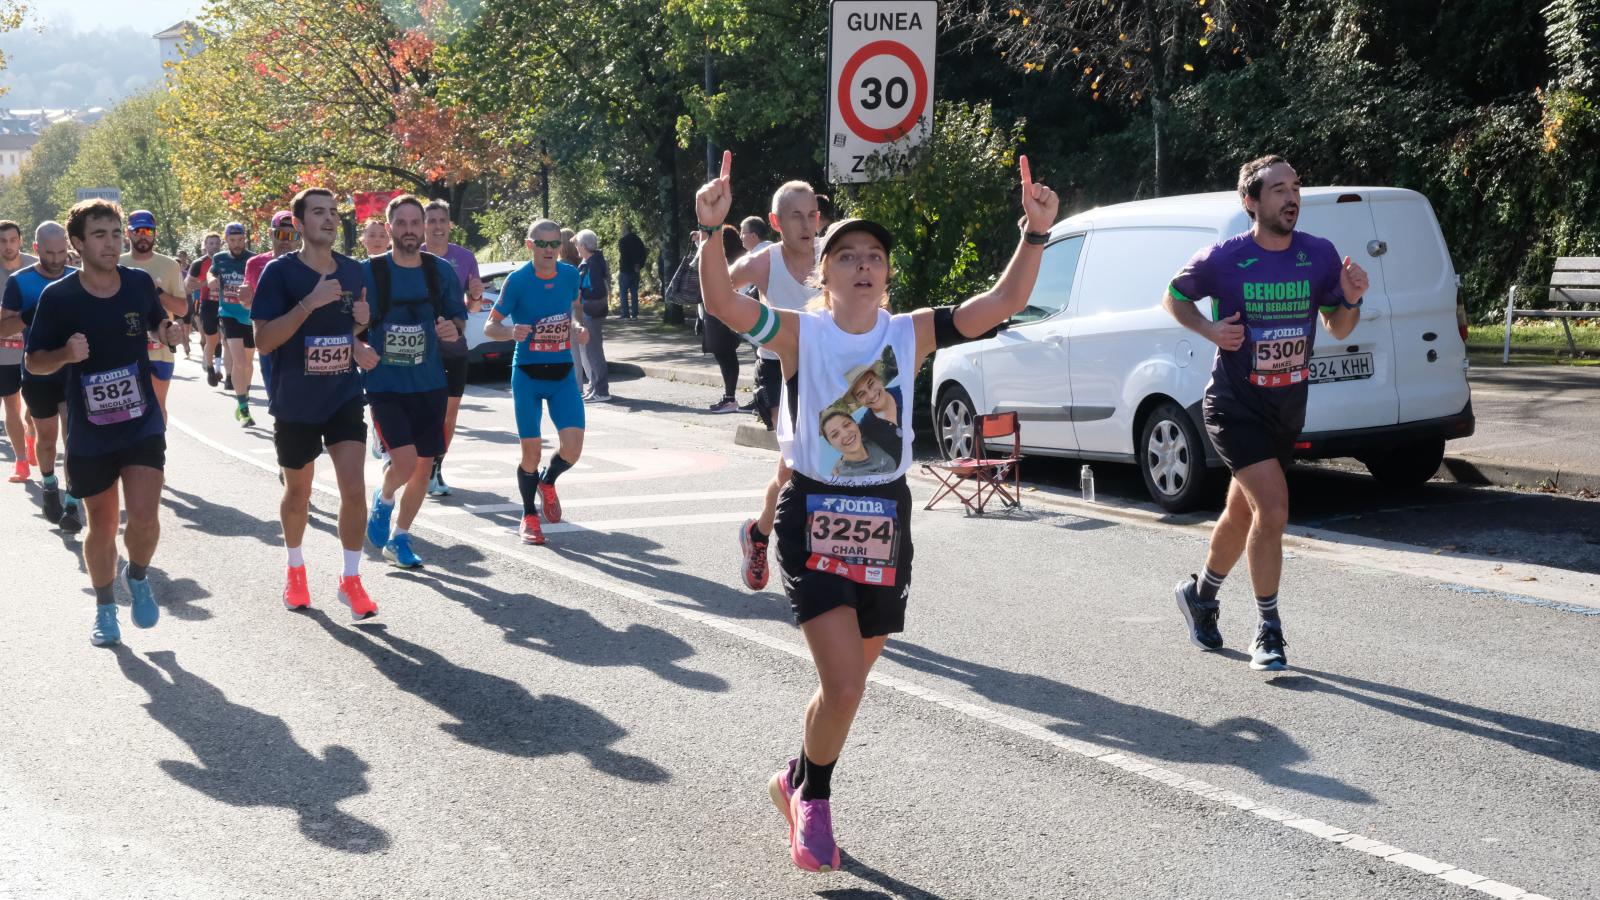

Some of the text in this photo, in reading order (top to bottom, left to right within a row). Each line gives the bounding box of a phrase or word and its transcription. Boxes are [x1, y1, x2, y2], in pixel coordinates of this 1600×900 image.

[847, 12, 922, 31] GUNEA
[860, 76, 909, 110] 30
[1243, 280, 1310, 300] BEHOBIA
[1245, 300, 1310, 313] SAN SEBASTIAN
[386, 333, 425, 347] 2302
[309, 347, 349, 363] 4541
[1258, 341, 1305, 361] 5300
[1342, 358, 1370, 376] KHH
[93, 380, 132, 401] 582
[99, 398, 132, 409] NICOLAS
[813, 517, 890, 544] 3254
[832, 546, 867, 555] CHARI
